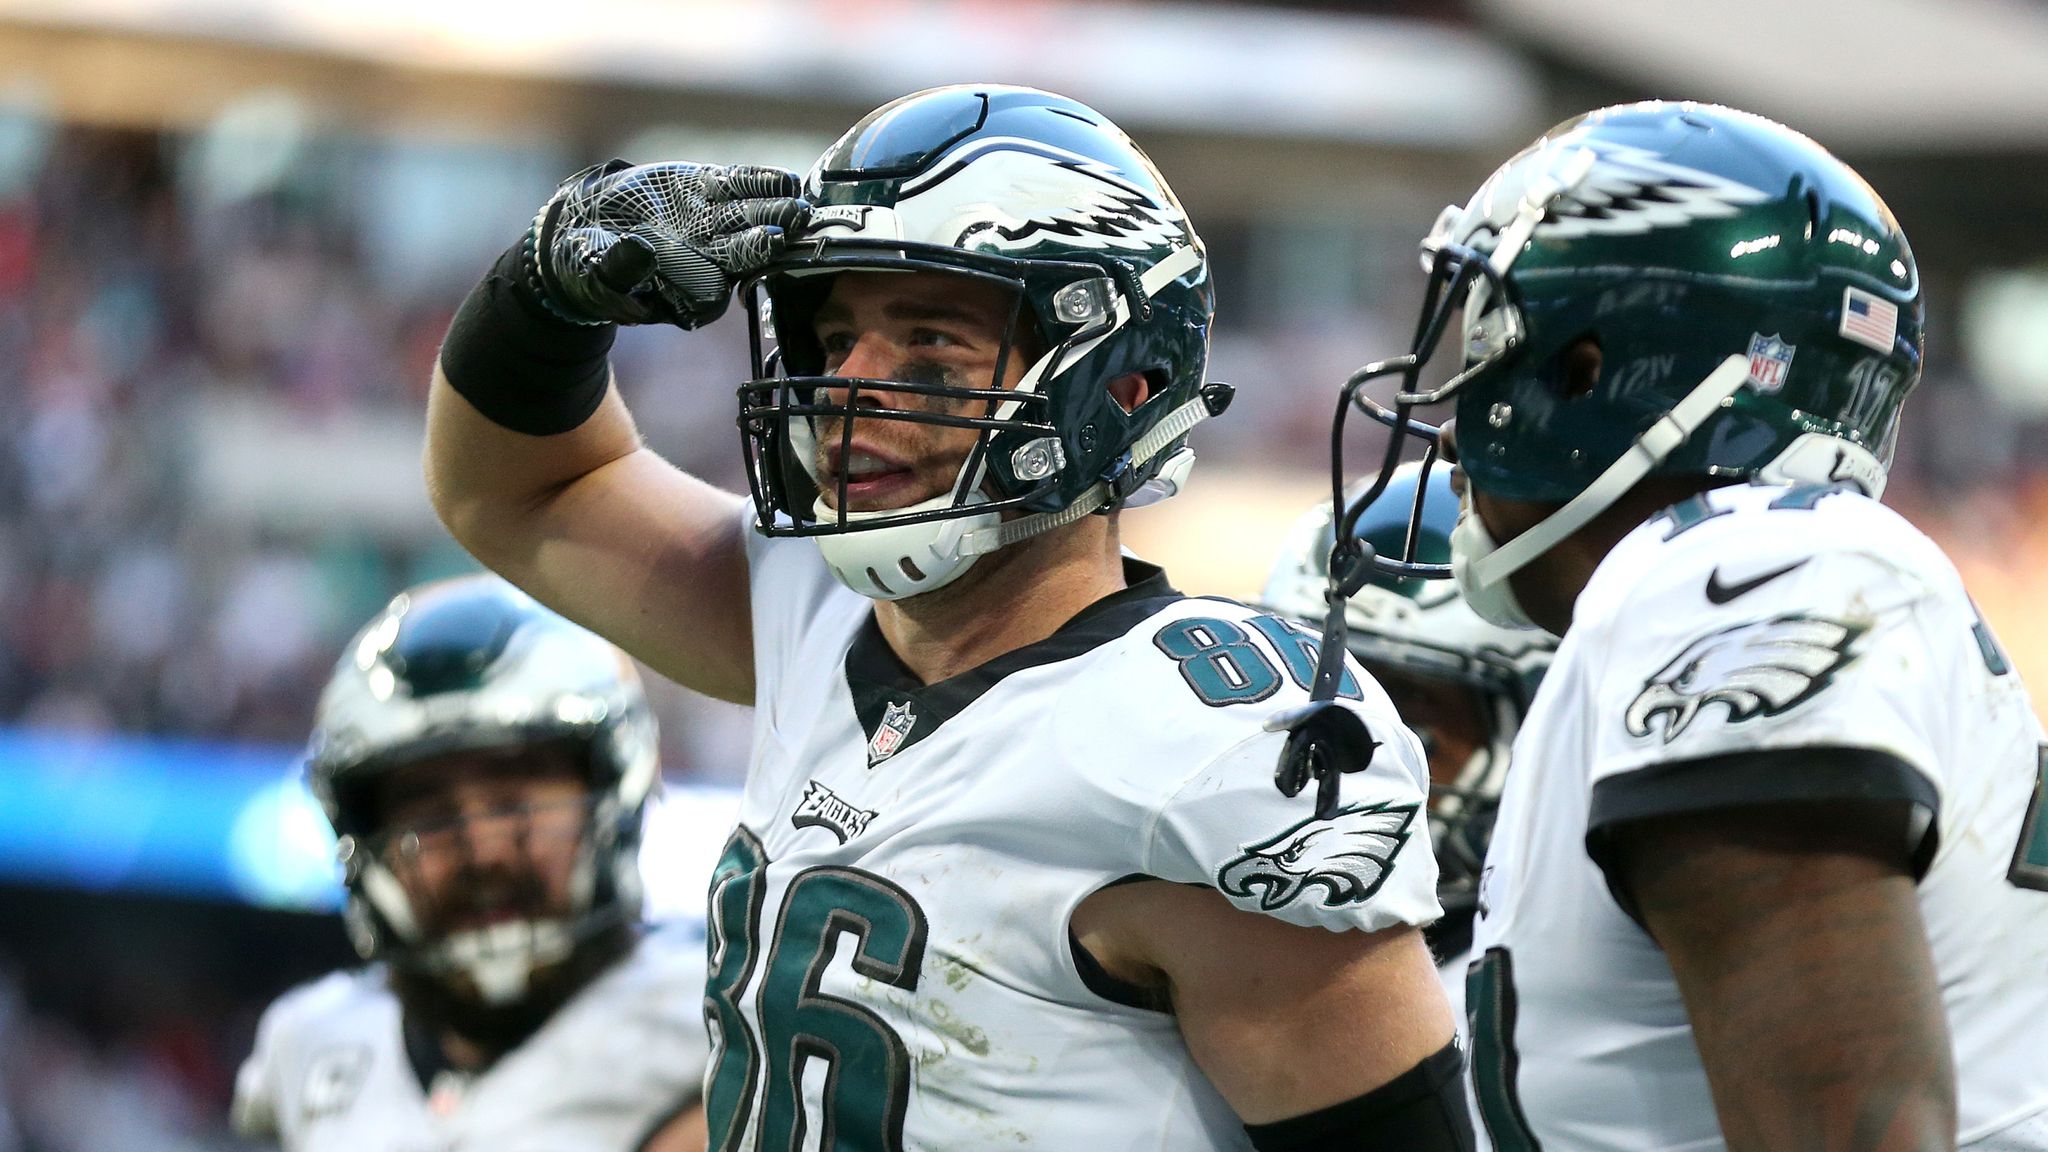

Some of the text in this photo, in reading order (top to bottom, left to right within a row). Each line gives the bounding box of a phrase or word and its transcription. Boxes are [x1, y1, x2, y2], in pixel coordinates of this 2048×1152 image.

[1750, 353, 1784, 386] NFL
[1153, 614, 1365, 707] 86
[792, 779, 878, 845] EAGLES
